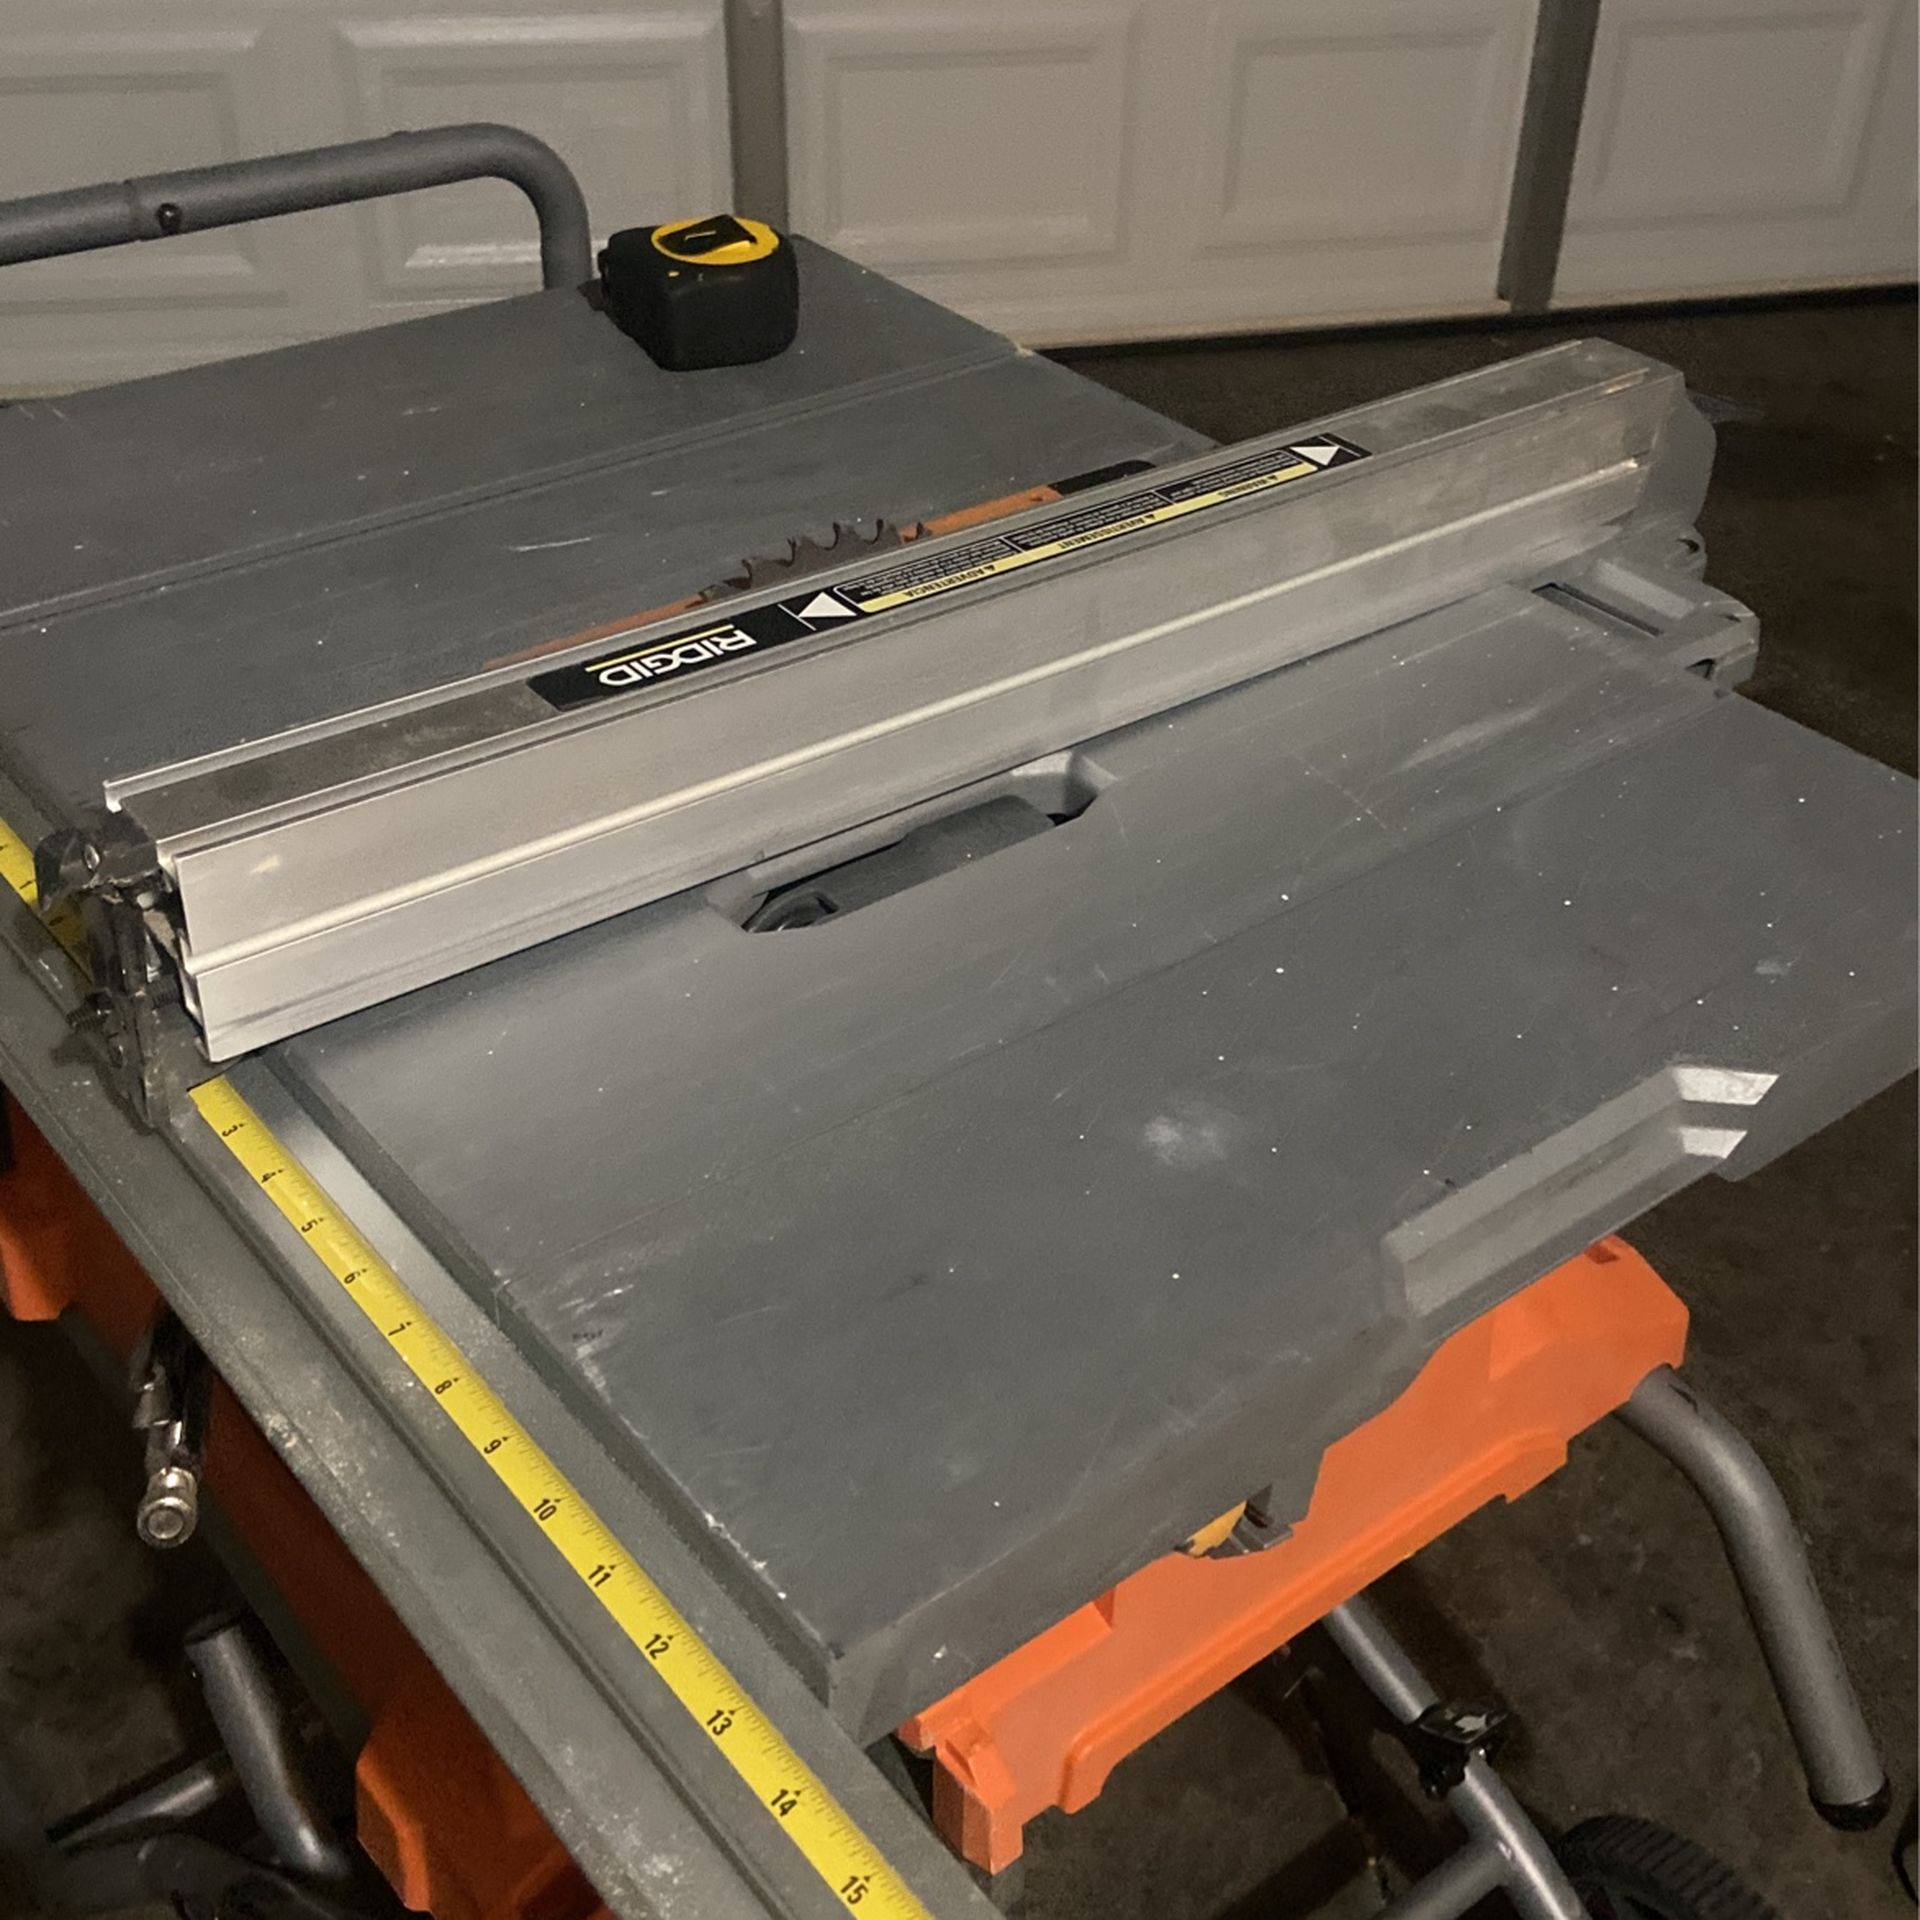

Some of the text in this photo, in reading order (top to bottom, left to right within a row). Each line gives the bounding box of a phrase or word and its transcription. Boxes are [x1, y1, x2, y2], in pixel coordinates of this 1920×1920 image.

[905, 567, 986, 598] ADVERTENCIA
[599, 629, 758, 686] RIDGID
[222, 1125, 869, 1905] 3 4 5 6 7 8 9 10 11 12 13 14 15
